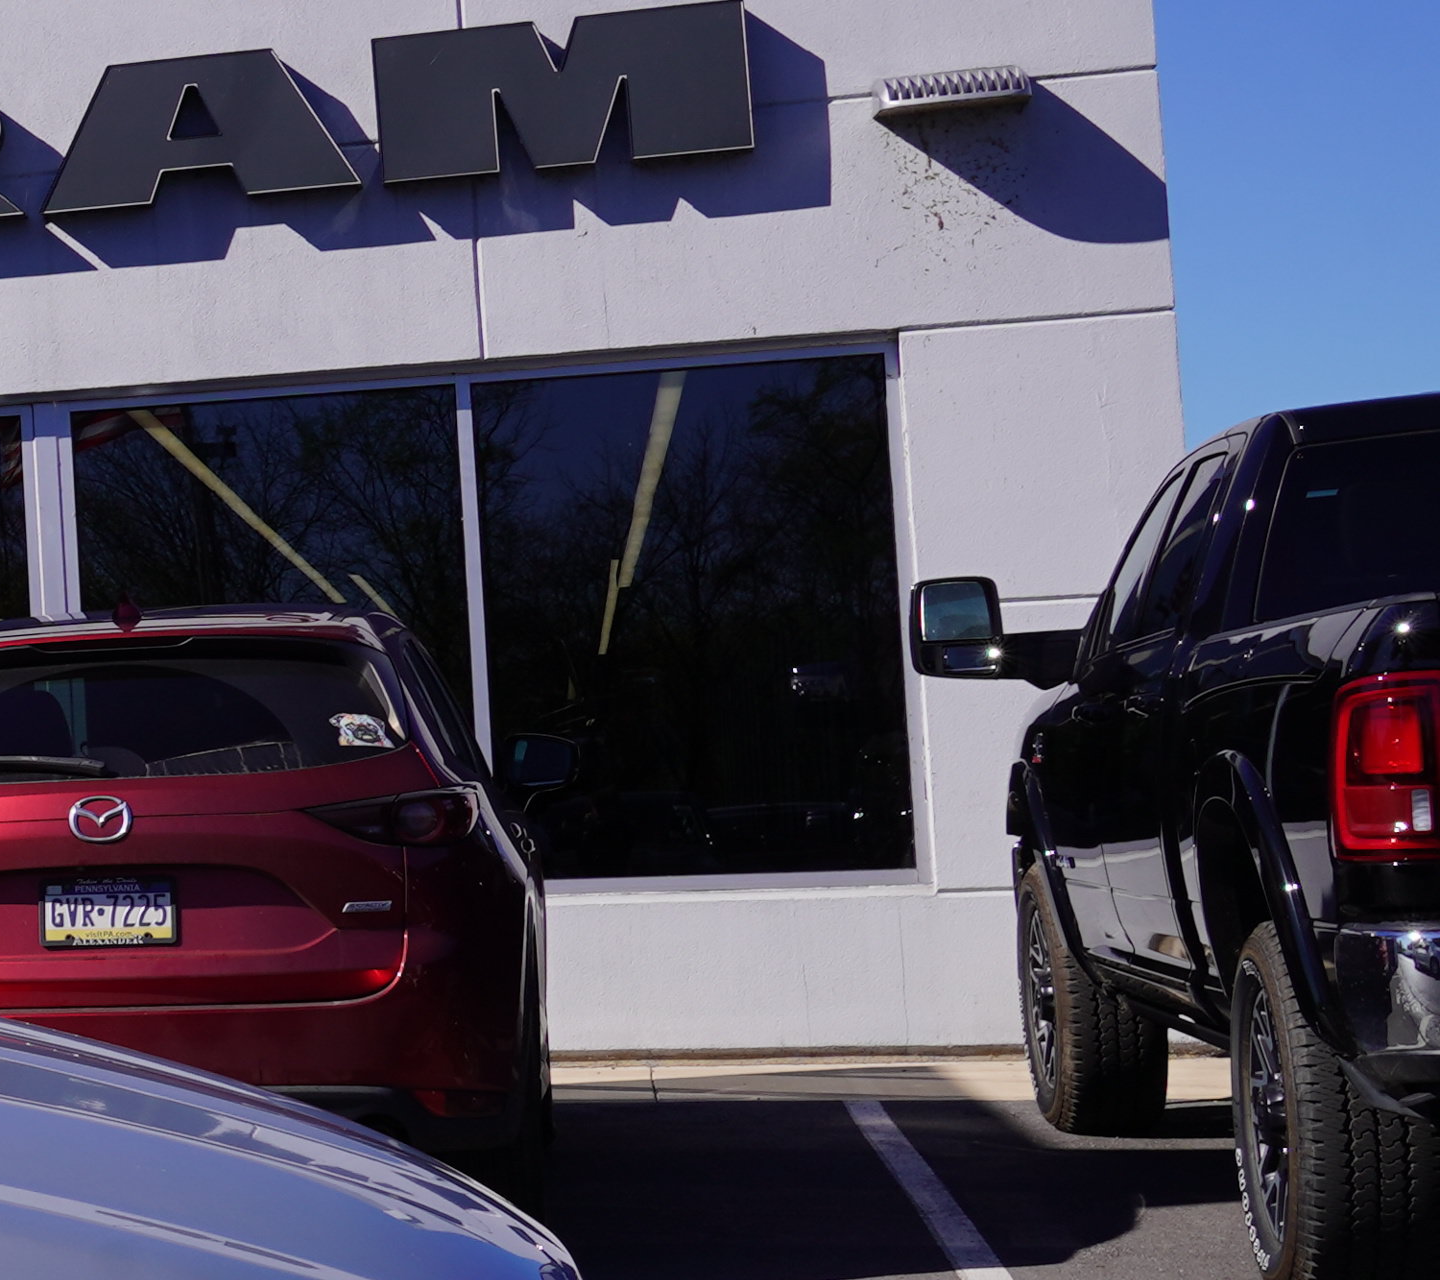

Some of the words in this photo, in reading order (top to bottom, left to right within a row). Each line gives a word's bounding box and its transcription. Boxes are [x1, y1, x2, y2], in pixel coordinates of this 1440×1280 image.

[74, 883, 141, 893] PENNSYLVANIA
[85, 930, 133, 938] visitPA.com
[72, 935, 144, 946] ALEXANDER
